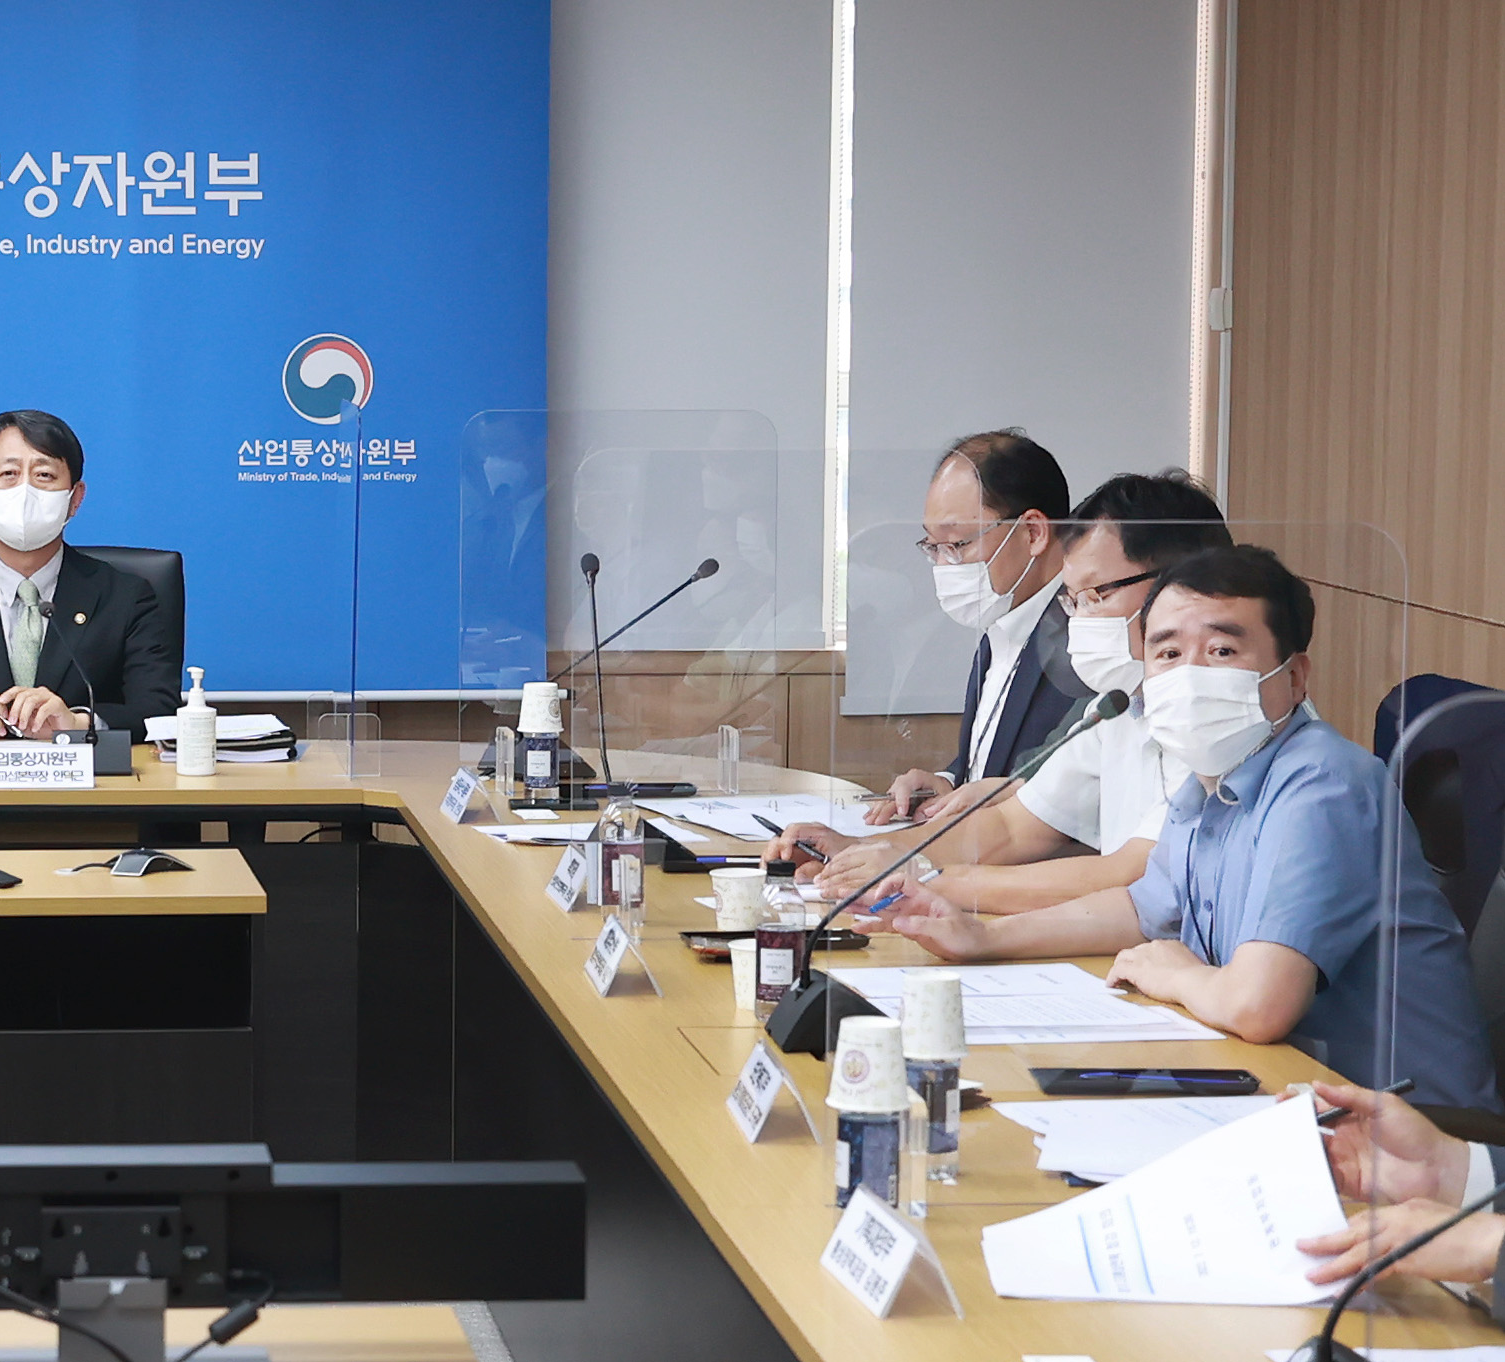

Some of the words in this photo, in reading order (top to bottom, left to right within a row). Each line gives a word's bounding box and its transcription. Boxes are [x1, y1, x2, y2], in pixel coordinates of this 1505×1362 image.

[26, 233, 123, 259] Industry
[128, 233, 174, 255] and
[182, 233, 265, 259] Energy
[237, 438, 417, 468] 산업통상원부
[238, 472, 276, 483] Ministry
[277, 471, 288, 482] of
[289, 471, 321, 483] Trade,
[362, 472, 381, 481] and
[383, 471, 417, 483] Energy
